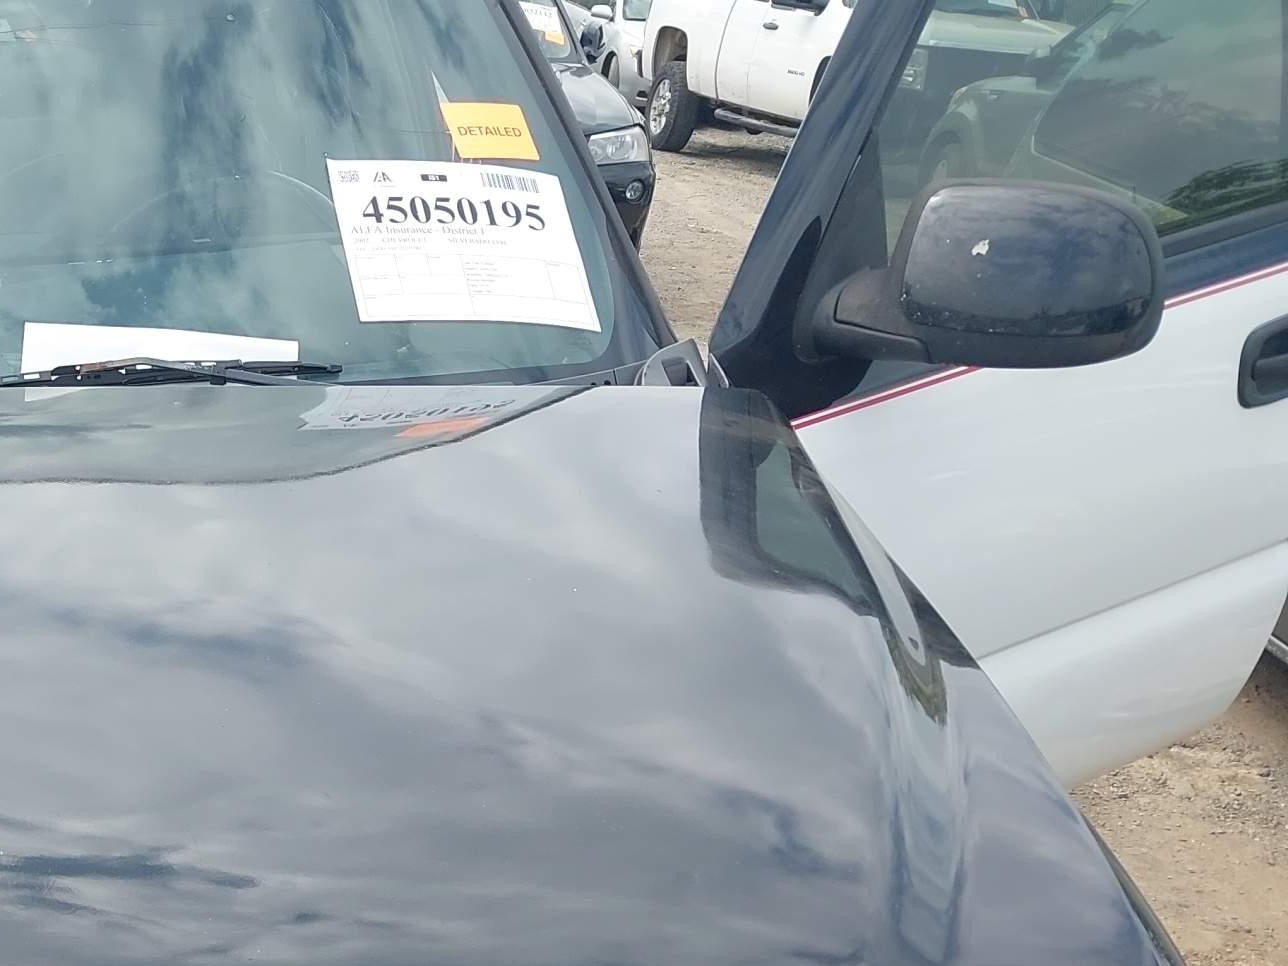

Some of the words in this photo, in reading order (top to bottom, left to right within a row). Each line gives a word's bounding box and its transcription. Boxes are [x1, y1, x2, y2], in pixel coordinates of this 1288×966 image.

[457, 125, 522, 138] DETAILED
[362, 195, 546, 231] 45050195
[385, 226, 433, 234] Insurance
